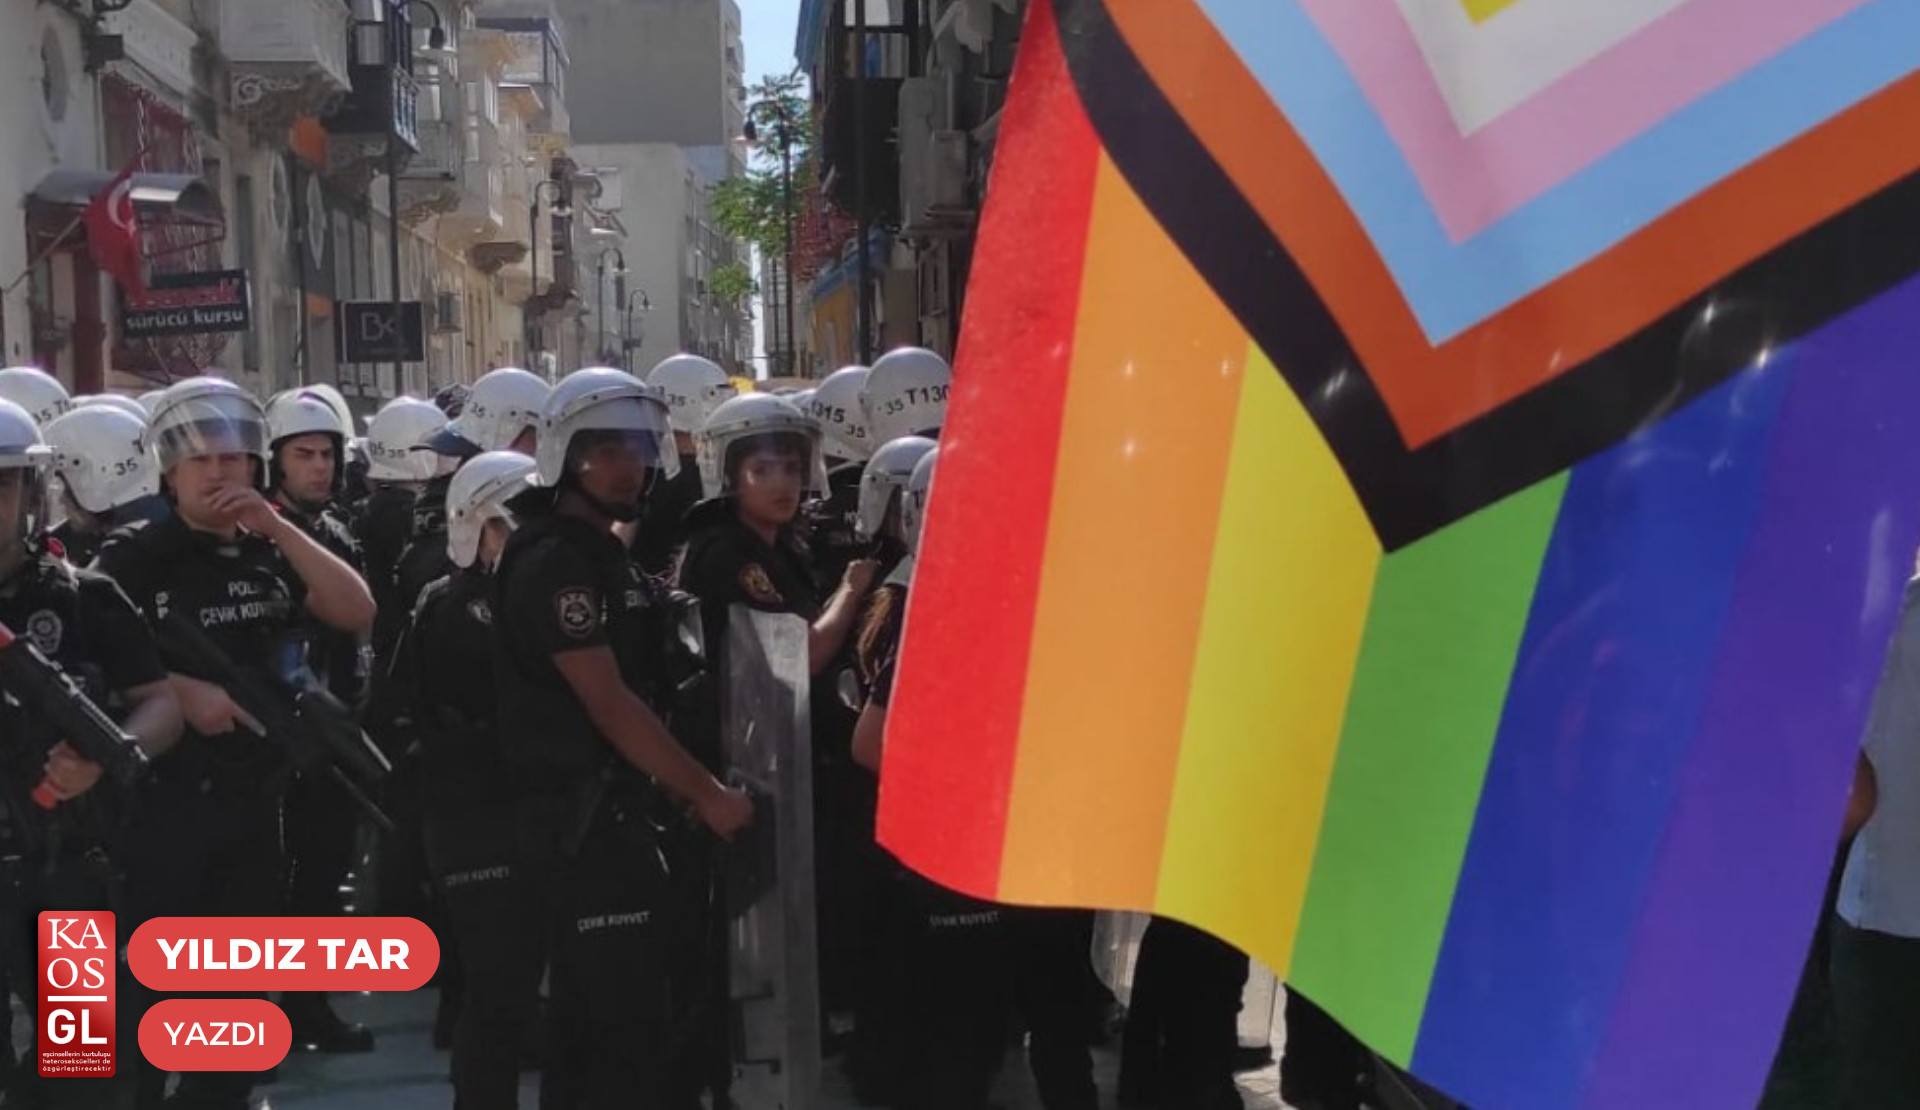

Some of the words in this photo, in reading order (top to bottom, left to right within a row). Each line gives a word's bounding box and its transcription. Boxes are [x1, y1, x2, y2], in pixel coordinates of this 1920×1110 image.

[126, 312, 188, 328] sürücü
[194, 308, 243, 324] kursu
[114, 457, 138, 476] 35
